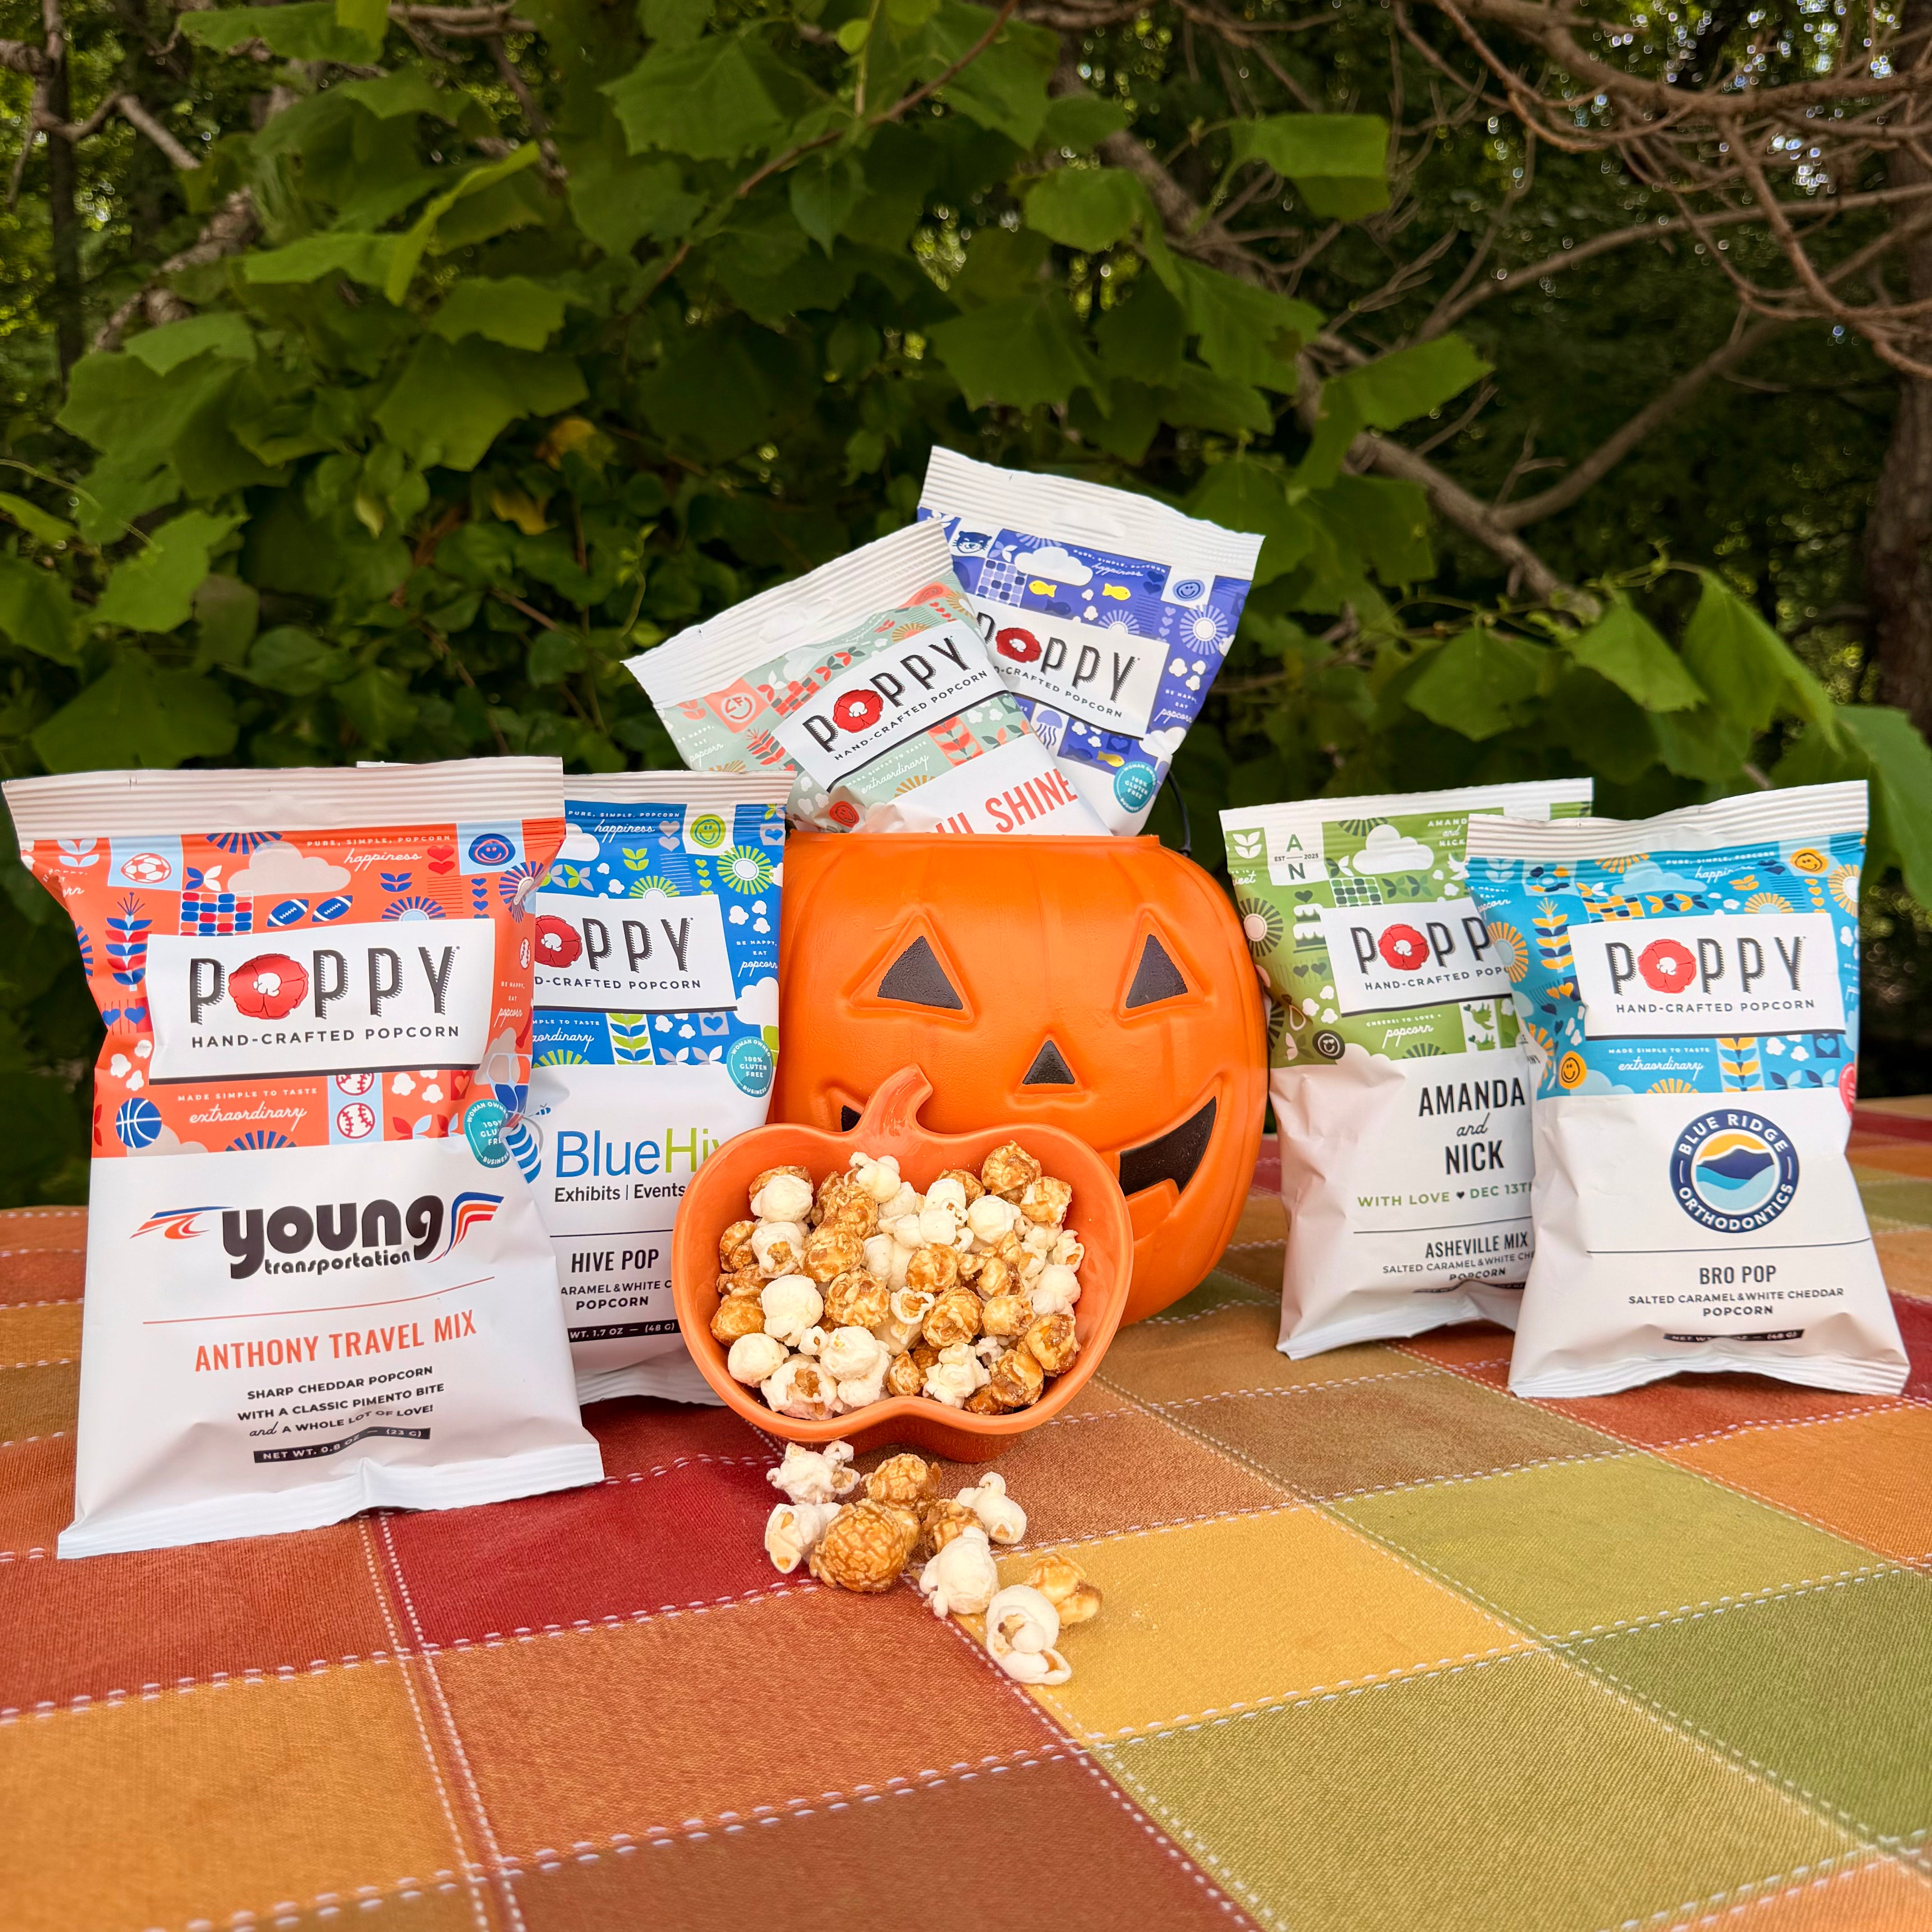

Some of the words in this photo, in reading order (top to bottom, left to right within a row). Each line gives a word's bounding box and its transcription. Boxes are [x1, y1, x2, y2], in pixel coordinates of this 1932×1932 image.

[802, 637, 971, 753] POPPY
[994, 666, 1059, 692] D-CRAFTED
[1065, 690, 1122, 718] POPCORN
[834, 702, 928, 761] HAND-CRAFTED
[931, 671, 988, 703] POPCORN
[690, 744, 724, 769] popcorn
[846, 776, 866, 787] MADE
[868, 759, 892, 776] SIMPLE
[906, 741, 927, 754] TASTE
[861, 755, 929, 794] extraordinary
[985, 768, 1078, 833] SHINE
[594, 819, 655, 843] happiness
[1428, 818, 1467, 827] AMAND
[1286, 834, 1303, 852] A
[1439, 838, 1465, 847] NICK
[344, 848, 422, 872] happiness
[1734, 851, 1775, 860] POPCORN
[1288, 863, 1306, 880] N
[1695, 865, 1755, 883] happin
[535, 915, 691, 974] OPPY
[1350, 917, 1492, 975] POPP
[737, 961, 778, 977] popcorn
[1605, 936, 1803, 996] POPPY
[190, 946, 456, 1025] POPPY
[535, 976, 621, 989] D-CRAFTED
[629, 980, 701, 989] POPCORN
[1365, 971, 1470, 990] HAND-CRAFTED
[493, 1007, 523, 1027] popcorn
[1616, 1003, 1733, 1013] HAND-CRAFTED
[1741, 999, 1814, 1012] POPCORN
[192, 1030, 354, 1048] HAND-CRAFTED
[366, 1026, 459, 1040] POPCORN
[533, 1027, 594, 1053] aordinary
[731, 1038, 752, 1055] WOMAN
[754, 1039, 771, 1057] OWNED
[1382, 1024, 1434, 1049] popcorn
[1618, 1056, 1704, 1081] extraordinary
[216, 1091, 258, 1099] SIMPLE
[1418, 1077, 1525, 1117] AMANDA
[189, 1100, 308, 1132] extraordinary
[466, 1102, 486, 1122] WOMAN
[1456, 1112, 1490, 1136] and
[1678, 1116, 1720, 1155] BLUE
[1727, 1113, 1789, 1152] RIDGE
[556, 1127, 721, 1178] BlueHi
[1445, 1140, 1504, 1175] NICK
[555, 1185, 621, 1202] Exhibits
[634, 1182, 686, 1199] Events
[1357, 1196, 1402, 1207] WITH
[1409, 1192, 1449, 1205] LOVE
[1470, 1186, 1499, 1199] DEC
[1679, 1184, 1794, 1231] ORTHODONTICS
[222, 1195, 444, 1279] young
[1425, 1235, 1499, 1258] ASHEVILLE
[1504, 1232, 1528, 1250] MIX
[265, 1250, 411, 1275] transportation
[571, 1251, 615, 1273] HIVE
[621, 1249, 659, 1270] POP
[1383, 1264, 1423, 1274] SALTED
[1426, 1260, 1476, 1271] CARAMEL
[1485, 1254, 1514, 1265] WHITE
[1449, 1268, 1506, 1281] POPCORN
[1699, 1267, 1734, 1285] BRO
[1742, 1265, 1776, 1283] POP
[561, 1284, 611, 1295] ARAMEL
[622, 1281, 661, 1292] WHITE
[1628, 1295, 1674, 1304] SALTED
[1678, 1293, 1736, 1303] CARAMEL
[1745, 1291, 1784, 1301] WHITE
[1787, 1288, 1844, 1298] CHEDDAR
[576, 1296, 649, 1310] POPCORN
[1703, 1306, 1773, 1316] POPCORN
[195, 1336, 319, 1372] ANTHONY
[329, 1322, 425, 1359] TRAVEL
[434, 1309, 477, 1343] MIX
[570, 1331, 589, 1339] WT.
[593, 1329, 606, 1337] 1.7
[645, 1324, 661, 1333] (48
[664, 1323, 675, 1331] G)
[247, 1387, 294, 1400] SHARP
[298, 1378, 364, 1394] CHEDDAR
[369, 1366, 433, 1385] POPCORN
[237, 1409, 274, 1421] WITH
[278, 1408, 289, 1416] A
[292, 1400, 348, 1414] CLASSIC
[353, 1390, 412, 1408] PIMENTO
[416, 1383, 445, 1396] BITE
[249, 1421, 279, 1437] and
[295, 1419, 345, 1431] WHOLE
[348, 1411, 372, 1424] LOT
[397, 1404, 434, 1417] LOVE!
[263, 1451, 288, 1459] NET
[292, 1448, 317, 1458] WT.
[321, 1443, 341, 1453] 0.8
[345, 1435, 360, 1445] OZ
